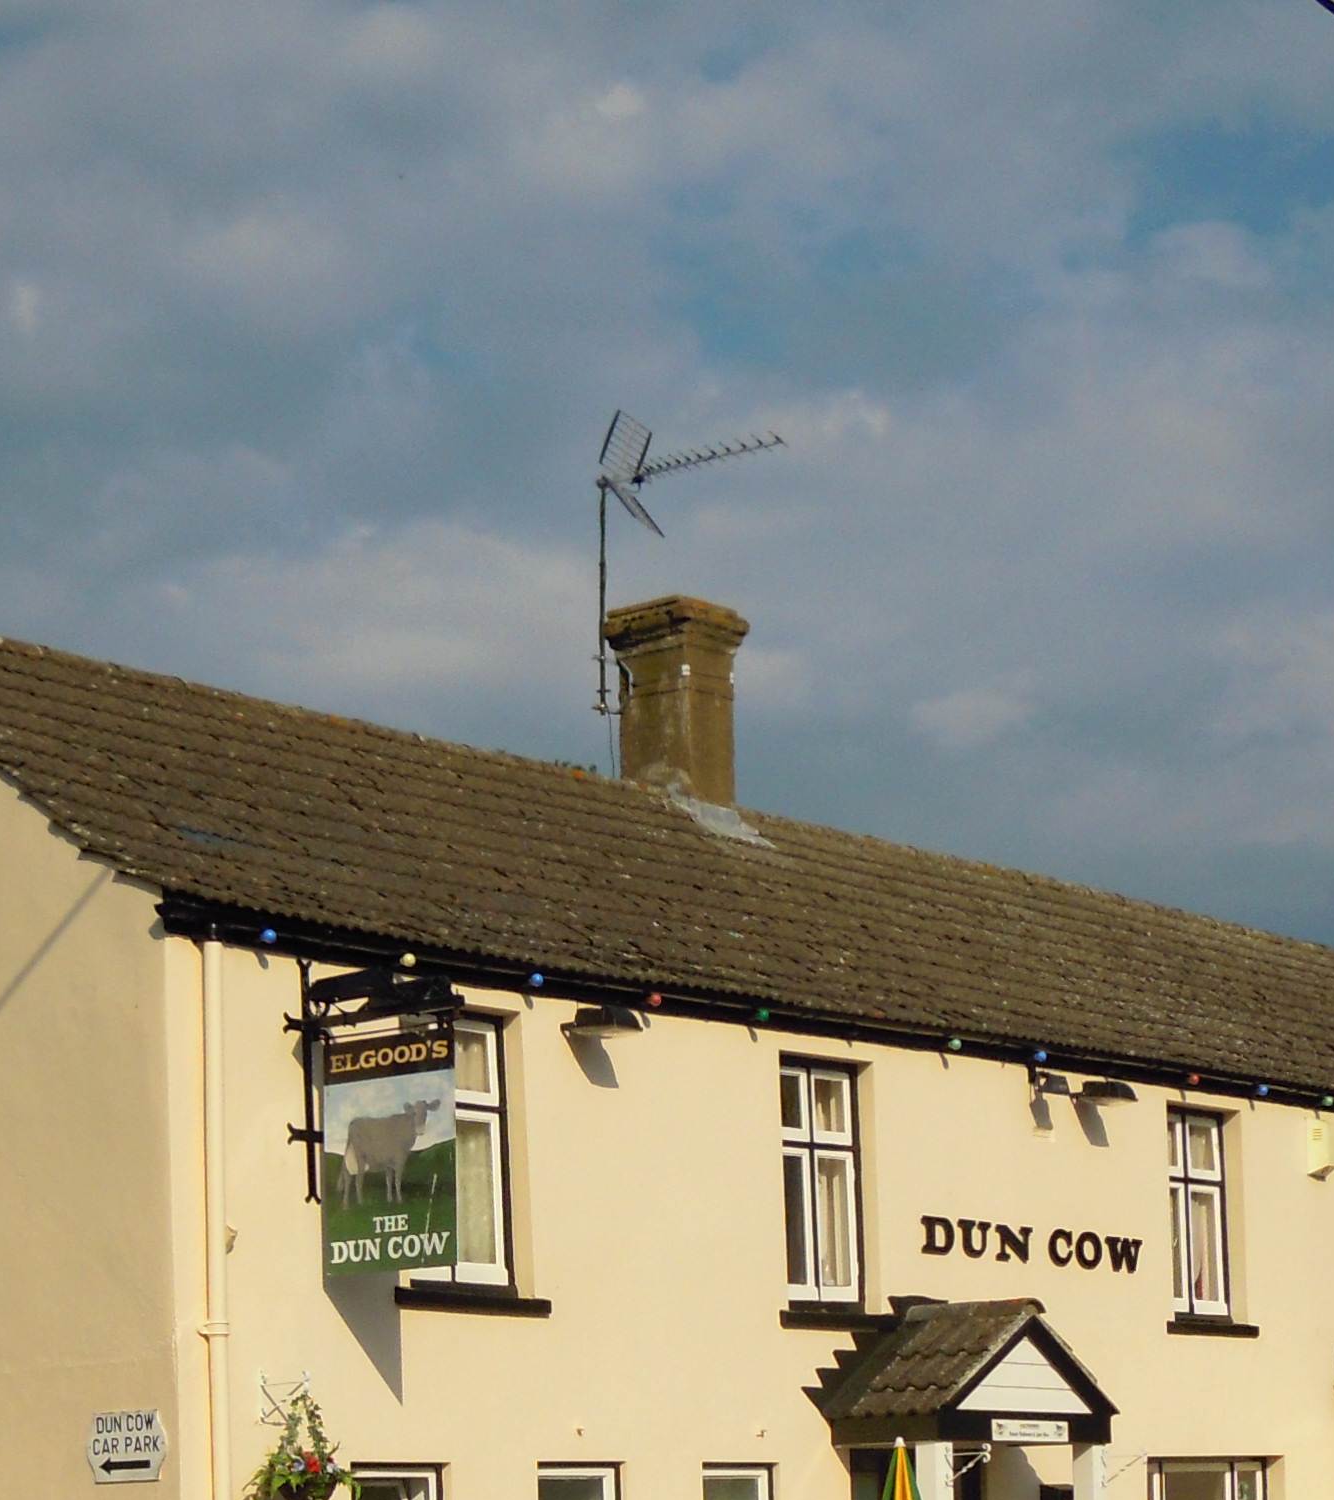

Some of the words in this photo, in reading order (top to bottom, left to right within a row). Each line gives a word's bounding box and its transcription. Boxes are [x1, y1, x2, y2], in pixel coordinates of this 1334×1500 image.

[330, 1040, 449, 1074] ELGOOD'S
[373, 1214, 409, 1233] THE
[330, 1237, 381, 1264] DUN
[387, 1231, 450, 1259] COW
[920, 1214, 1034, 1263] DUN
[1048, 1229, 1143, 1274] COW
[96, 1416, 122, 1434] DUN
[126, 1413, 154, 1432] COW
[92, 1437, 119, 1456] CAR
[124, 1435, 160, 1454] PARK
